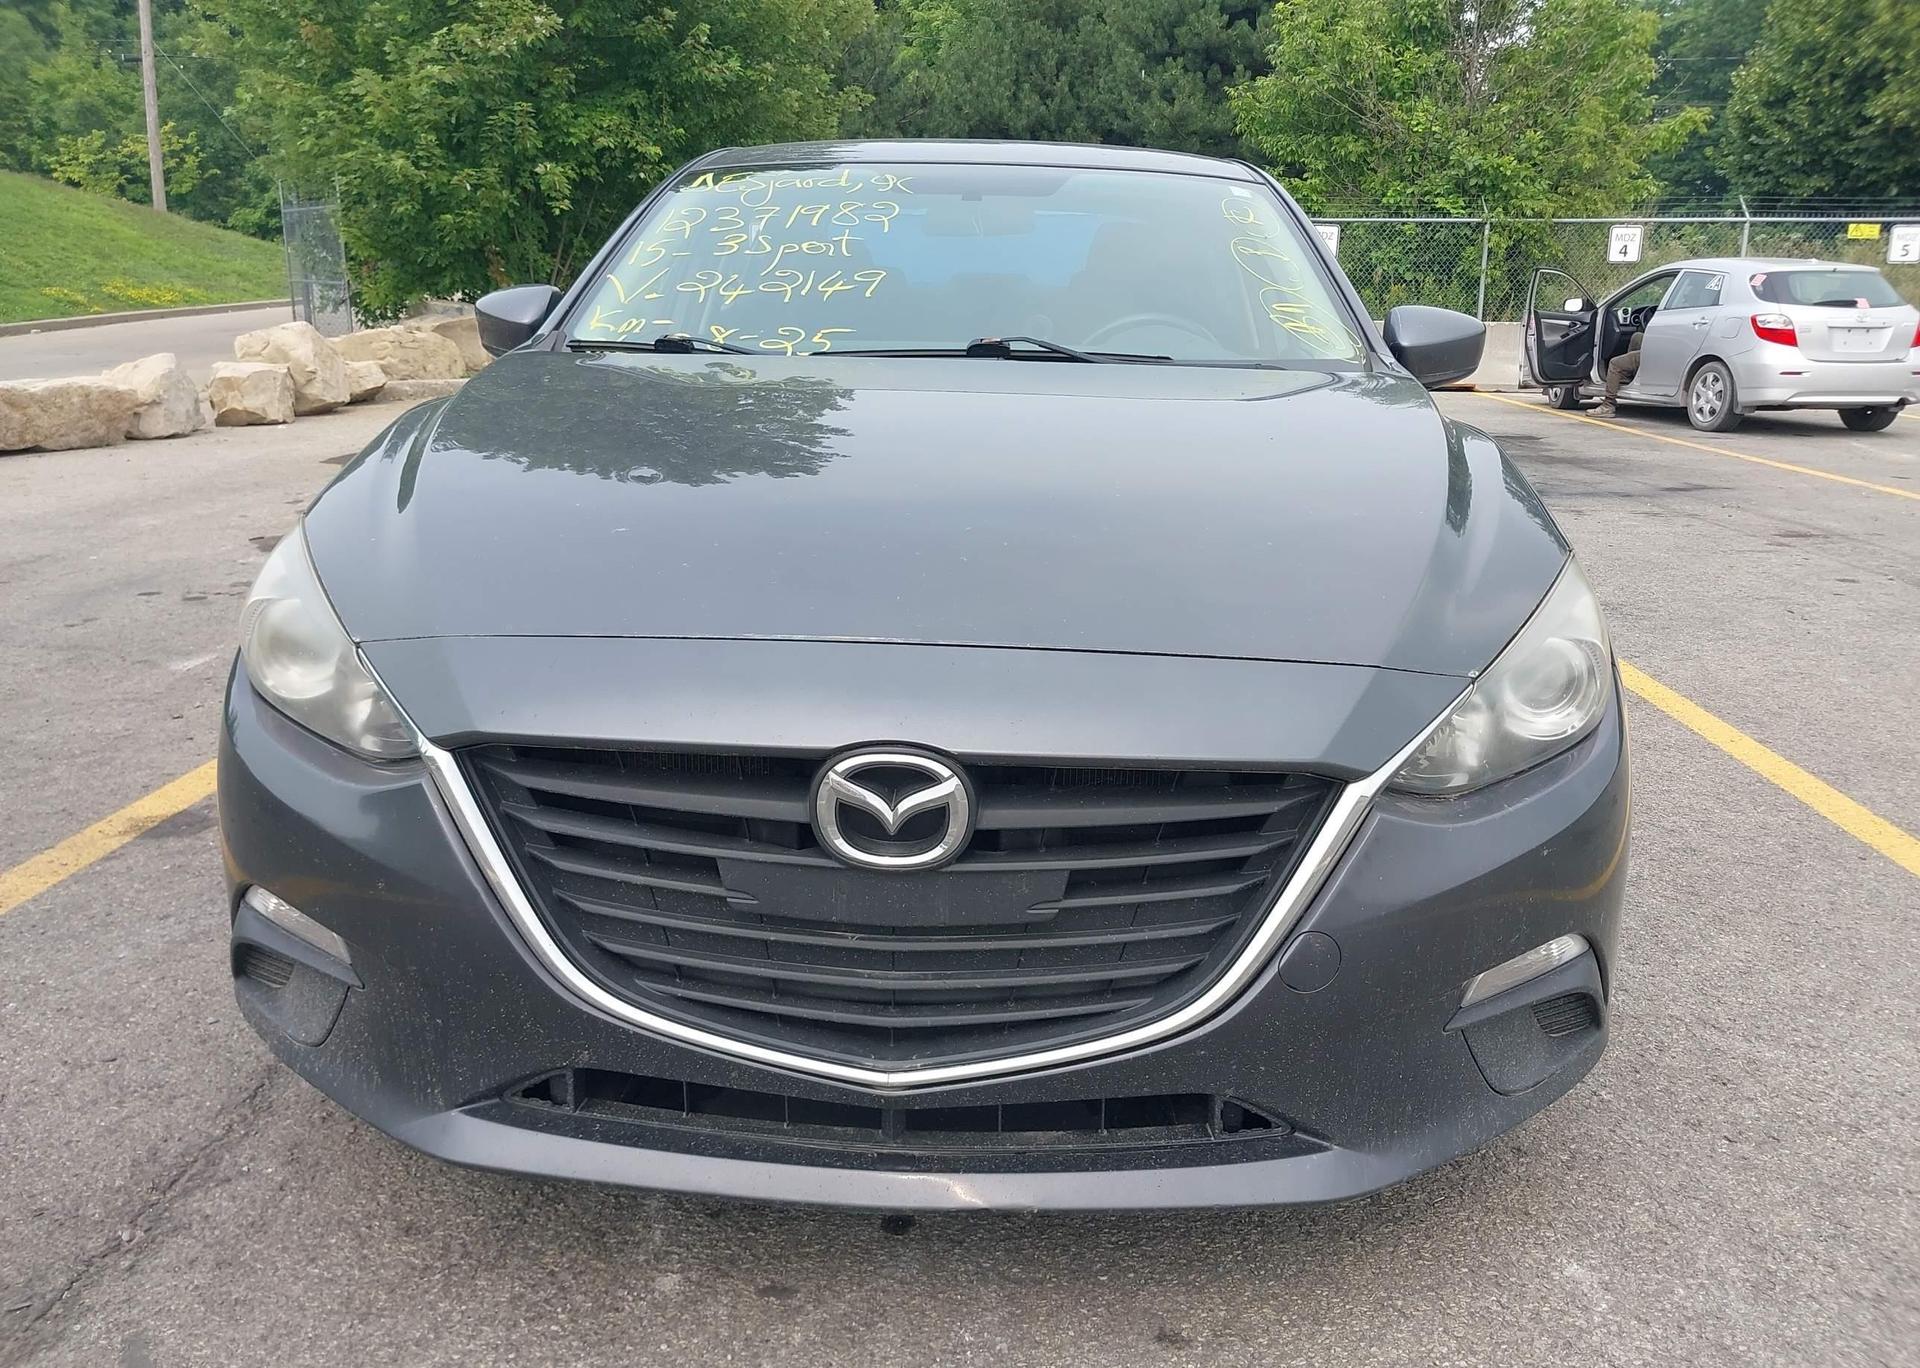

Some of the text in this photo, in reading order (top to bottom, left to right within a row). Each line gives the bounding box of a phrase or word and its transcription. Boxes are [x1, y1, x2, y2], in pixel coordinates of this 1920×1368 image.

[1615, 233, 1637, 242] MDZ
[1619, 244, 1628, 257] 4
[1899, 243, 1911, 257] 5
